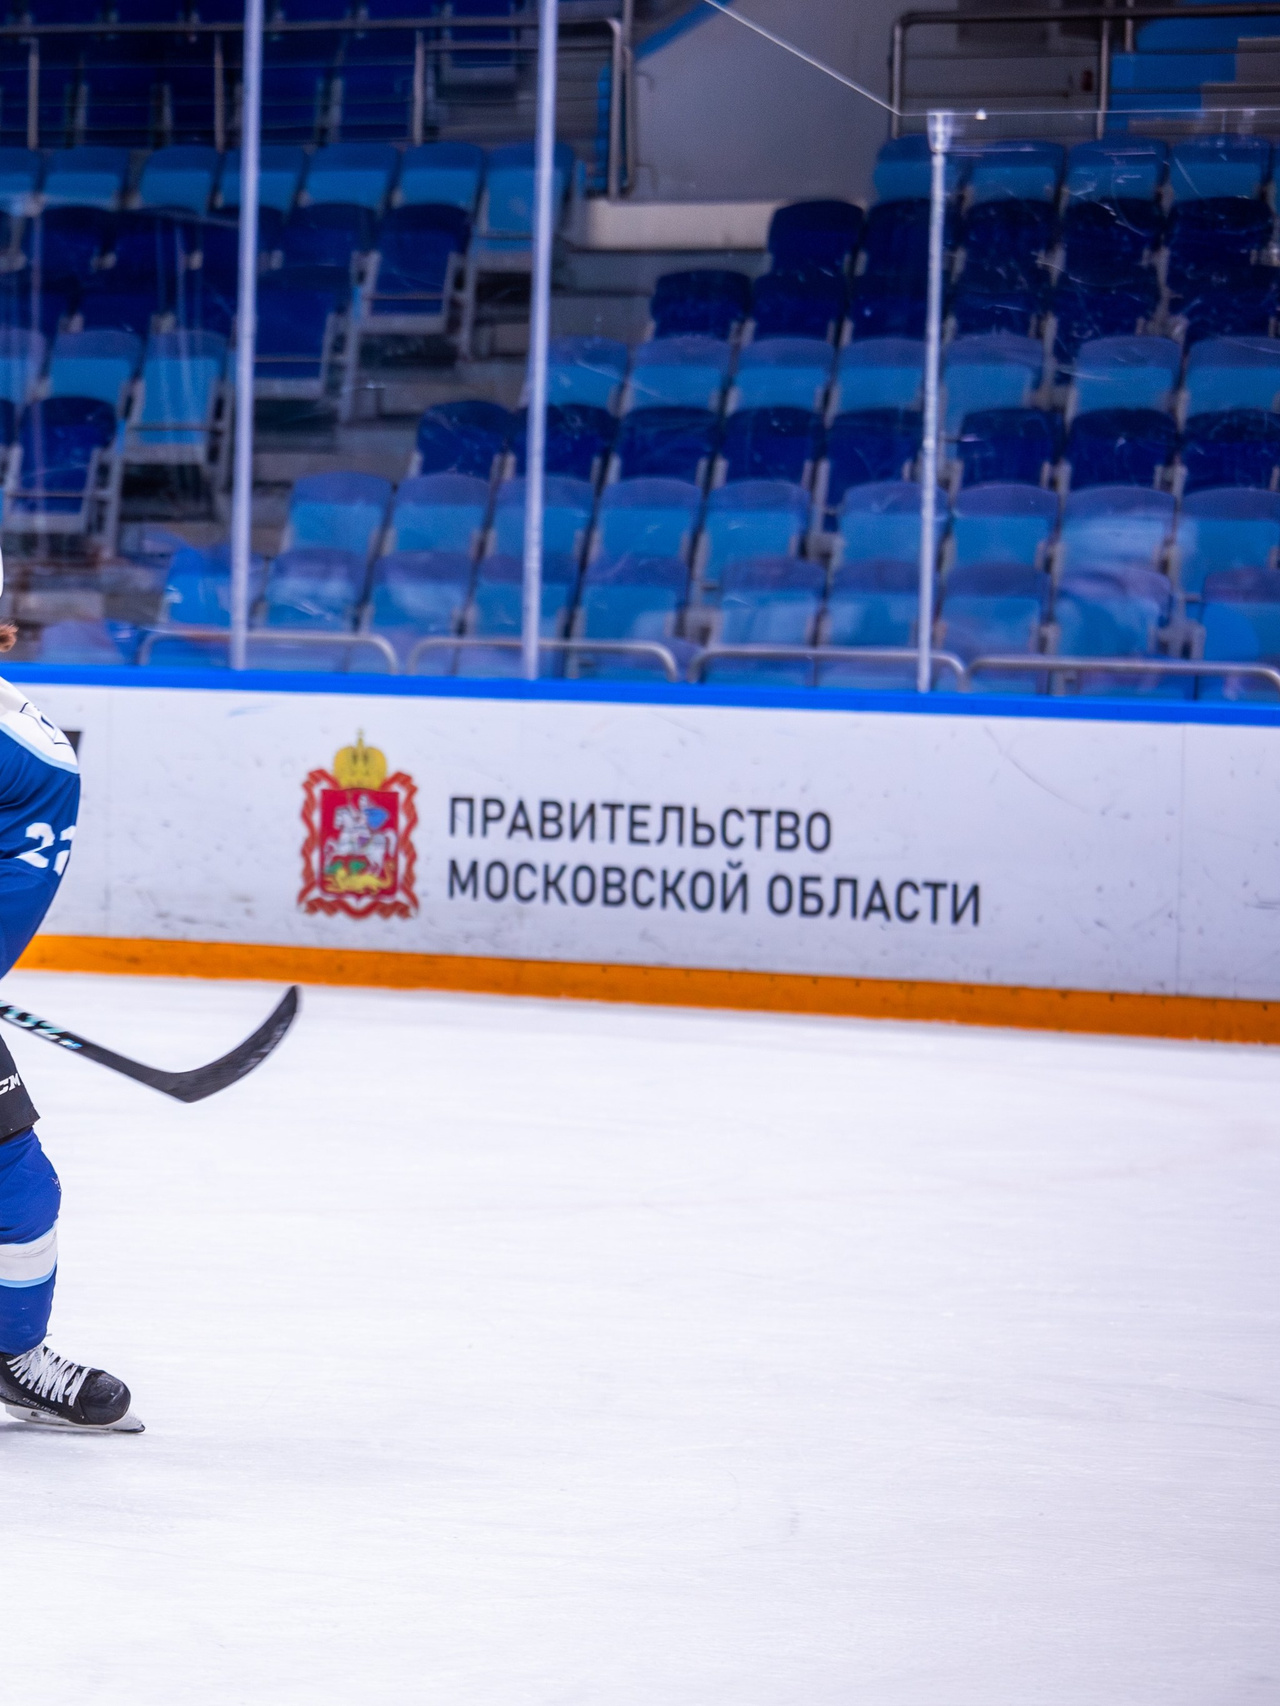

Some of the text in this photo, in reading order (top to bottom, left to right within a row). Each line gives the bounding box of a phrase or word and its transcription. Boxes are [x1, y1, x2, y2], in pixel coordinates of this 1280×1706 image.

[448, 797, 832, 853] ПРАВИТЕЛЬСТВО
[448, 859, 981, 926] МОСКОВСКОЙ ОБЛАСТИ
